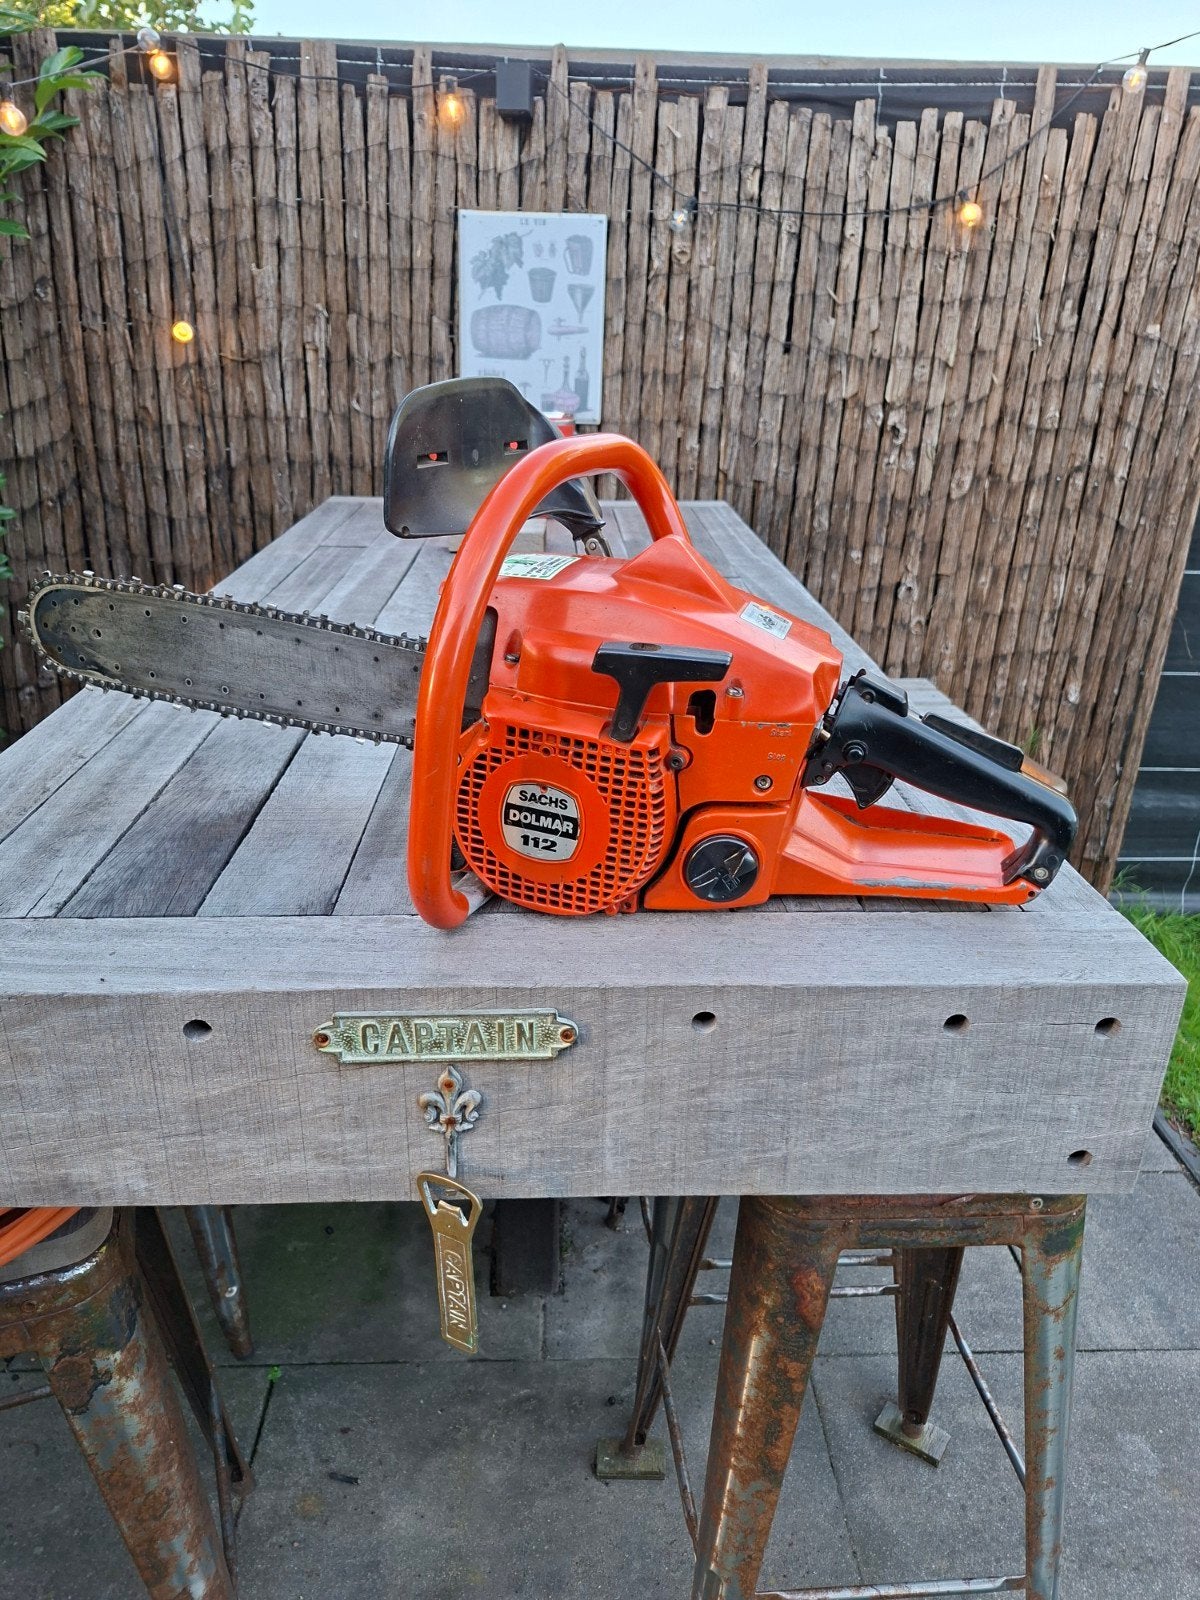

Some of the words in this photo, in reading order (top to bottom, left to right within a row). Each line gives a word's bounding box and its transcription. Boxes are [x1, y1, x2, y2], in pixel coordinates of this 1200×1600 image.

[518, 790, 568, 810] SACHS
[509, 809, 574, 834] DOLMAR
[521, 834, 558, 853] 112
[360, 1020, 536, 1055] CAPTAIN
[444, 1250, 467, 1330] CAPTAIN
